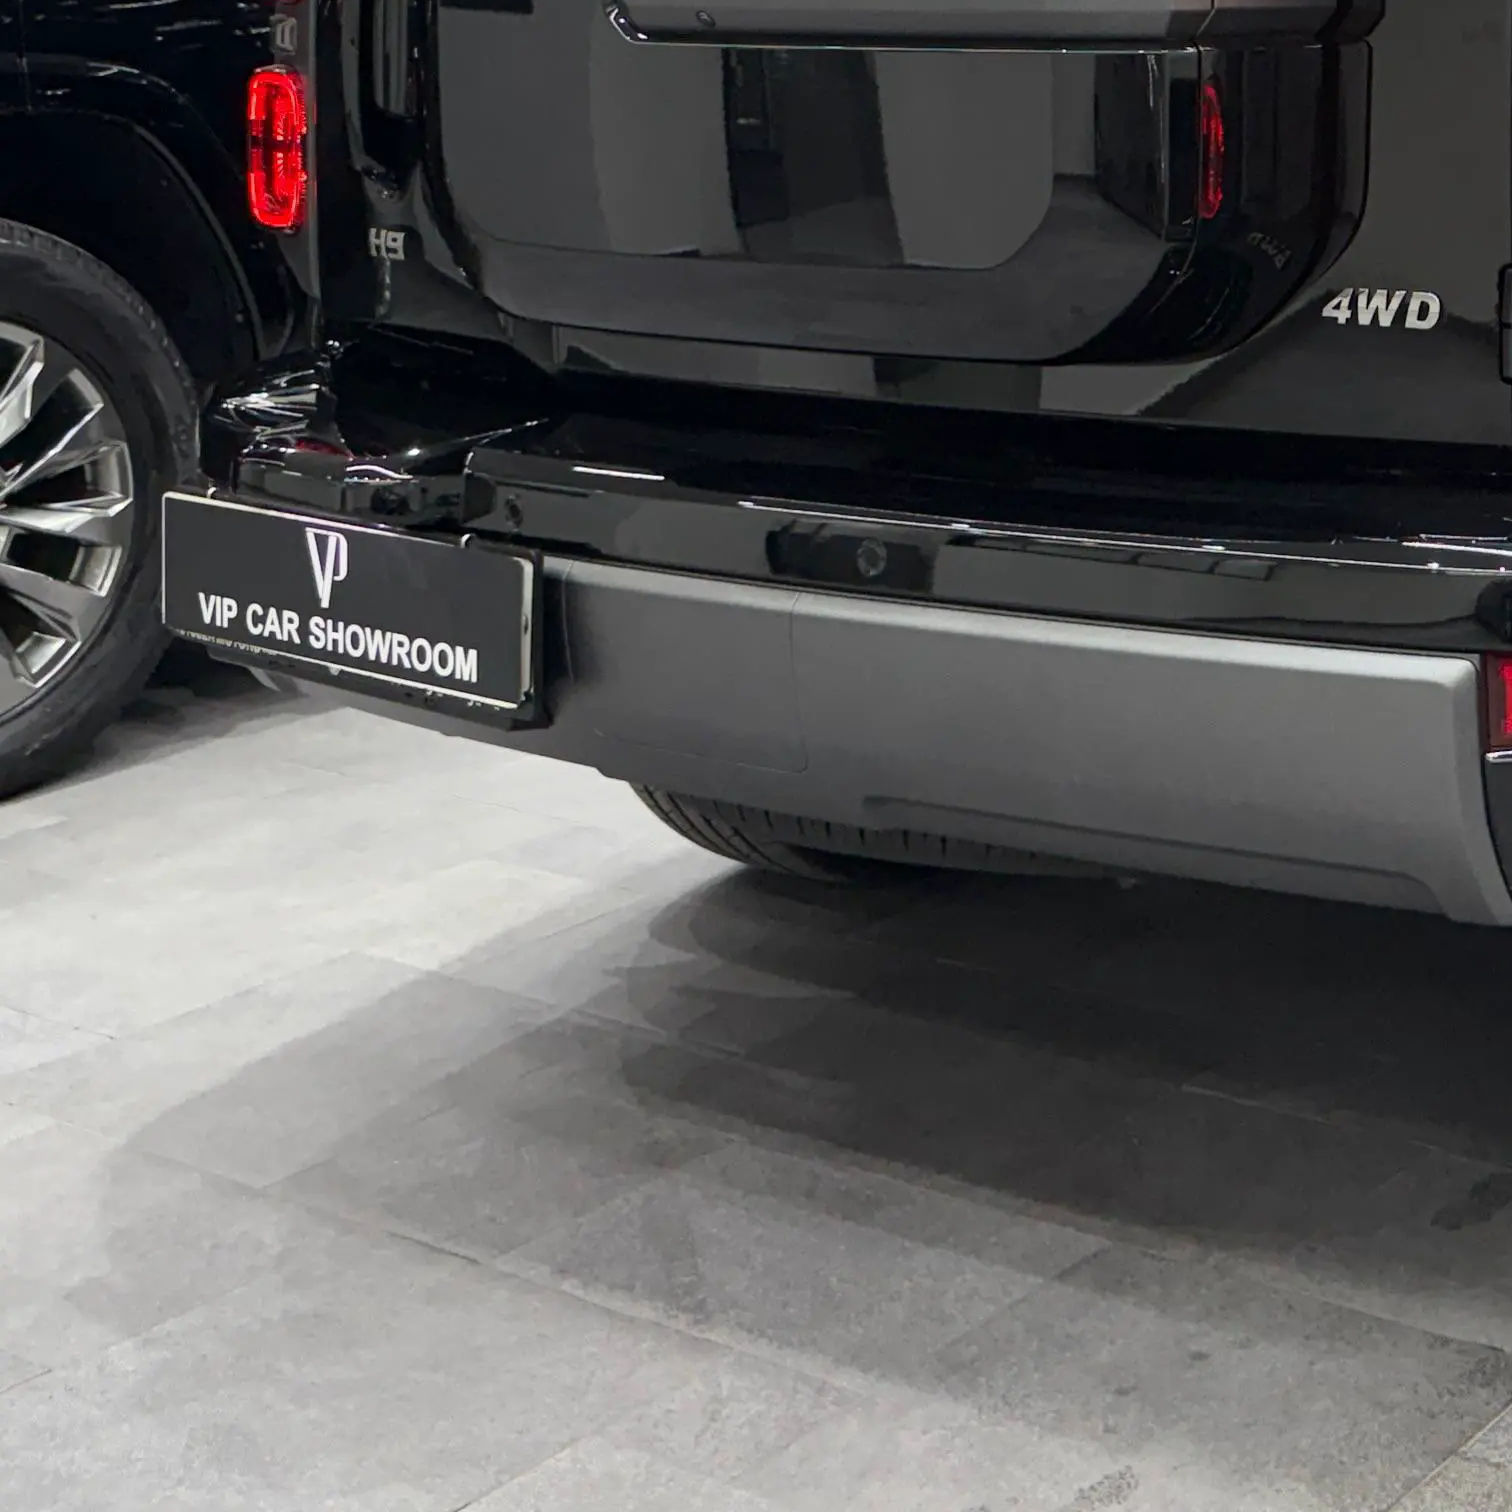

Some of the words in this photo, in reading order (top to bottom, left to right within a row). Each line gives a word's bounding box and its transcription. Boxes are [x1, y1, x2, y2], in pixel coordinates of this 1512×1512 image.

[369, 227, 405, 260] H9
[1322, 287, 1441, 330] 4WD
[198, 592, 238, 629] VIP
[245, 602, 301, 644] CAR
[308, 615, 478, 684] SHOWROOM
